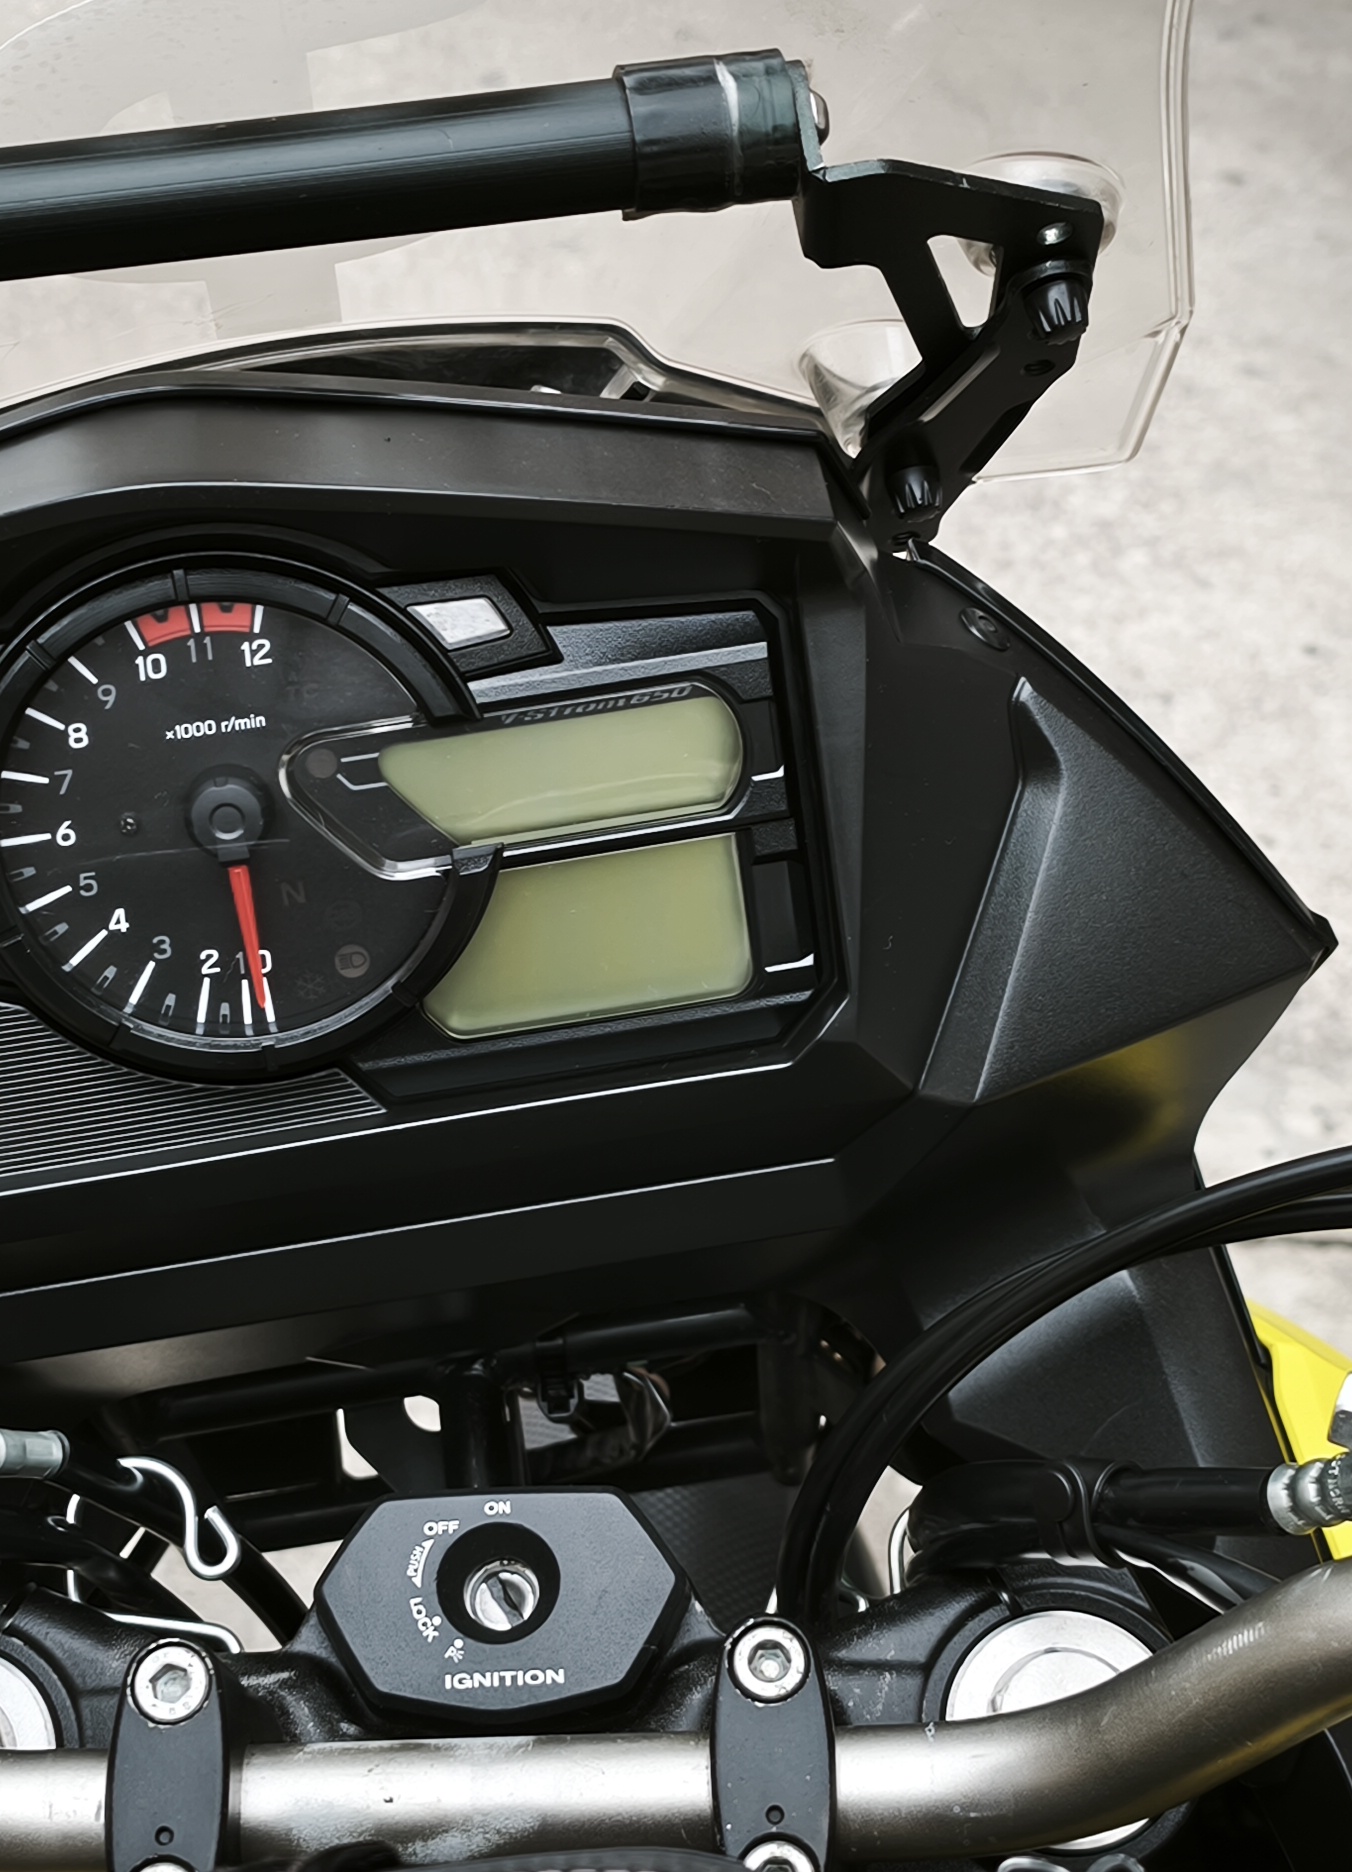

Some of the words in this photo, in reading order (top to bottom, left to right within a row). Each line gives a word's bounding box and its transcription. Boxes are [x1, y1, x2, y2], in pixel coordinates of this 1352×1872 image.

[187, 637, 214, 664] 11
[240, 639, 273, 667] 12
[135, 654, 167, 681] 10
[97, 684, 117, 710] 9
[67, 723, 89, 748] 8
[220, 712, 266, 735] r/min
[54, 769, 73, 795] 7
[56, 822, 76, 845] 6
[78, 872, 98, 897] 5
[280, 881, 306, 906] N
[108, 908, 130, 933] 4
[152, 936, 172, 959] 3
[199, 949, 221, 974] 2
[483, 1500, 511, 1516] ON
[423, 1519, 460, 1537] OFF
[406, 1545, 424, 1579] PUSH
[409, 1597, 440, 1642] LOCK
[444, 1668, 565, 1691] IGNITION
